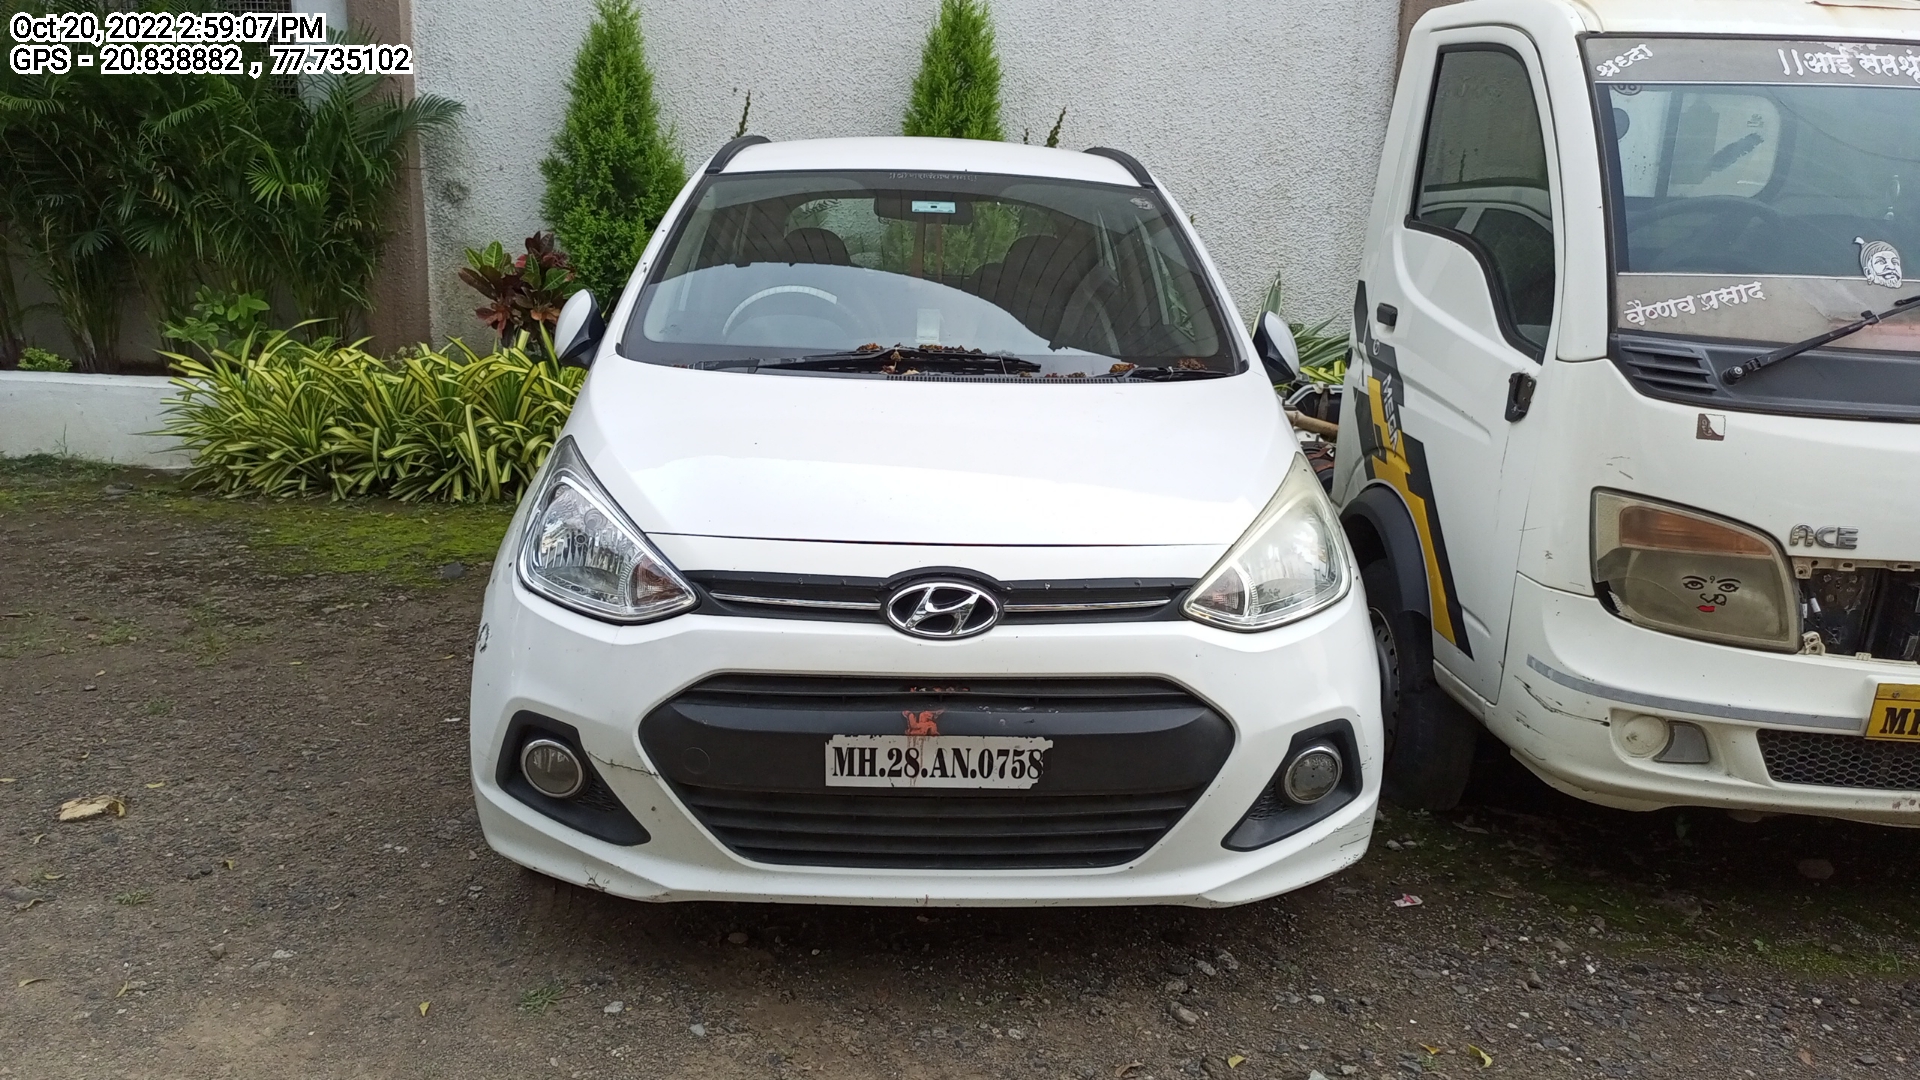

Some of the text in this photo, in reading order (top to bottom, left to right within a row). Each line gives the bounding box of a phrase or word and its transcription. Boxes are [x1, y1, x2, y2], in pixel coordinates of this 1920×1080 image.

[1382, 372, 1400, 458] MEGA
[1789, 523, 1859, 550] ACE
[831, 745, 1044, 780] MH.28.AN.0758
